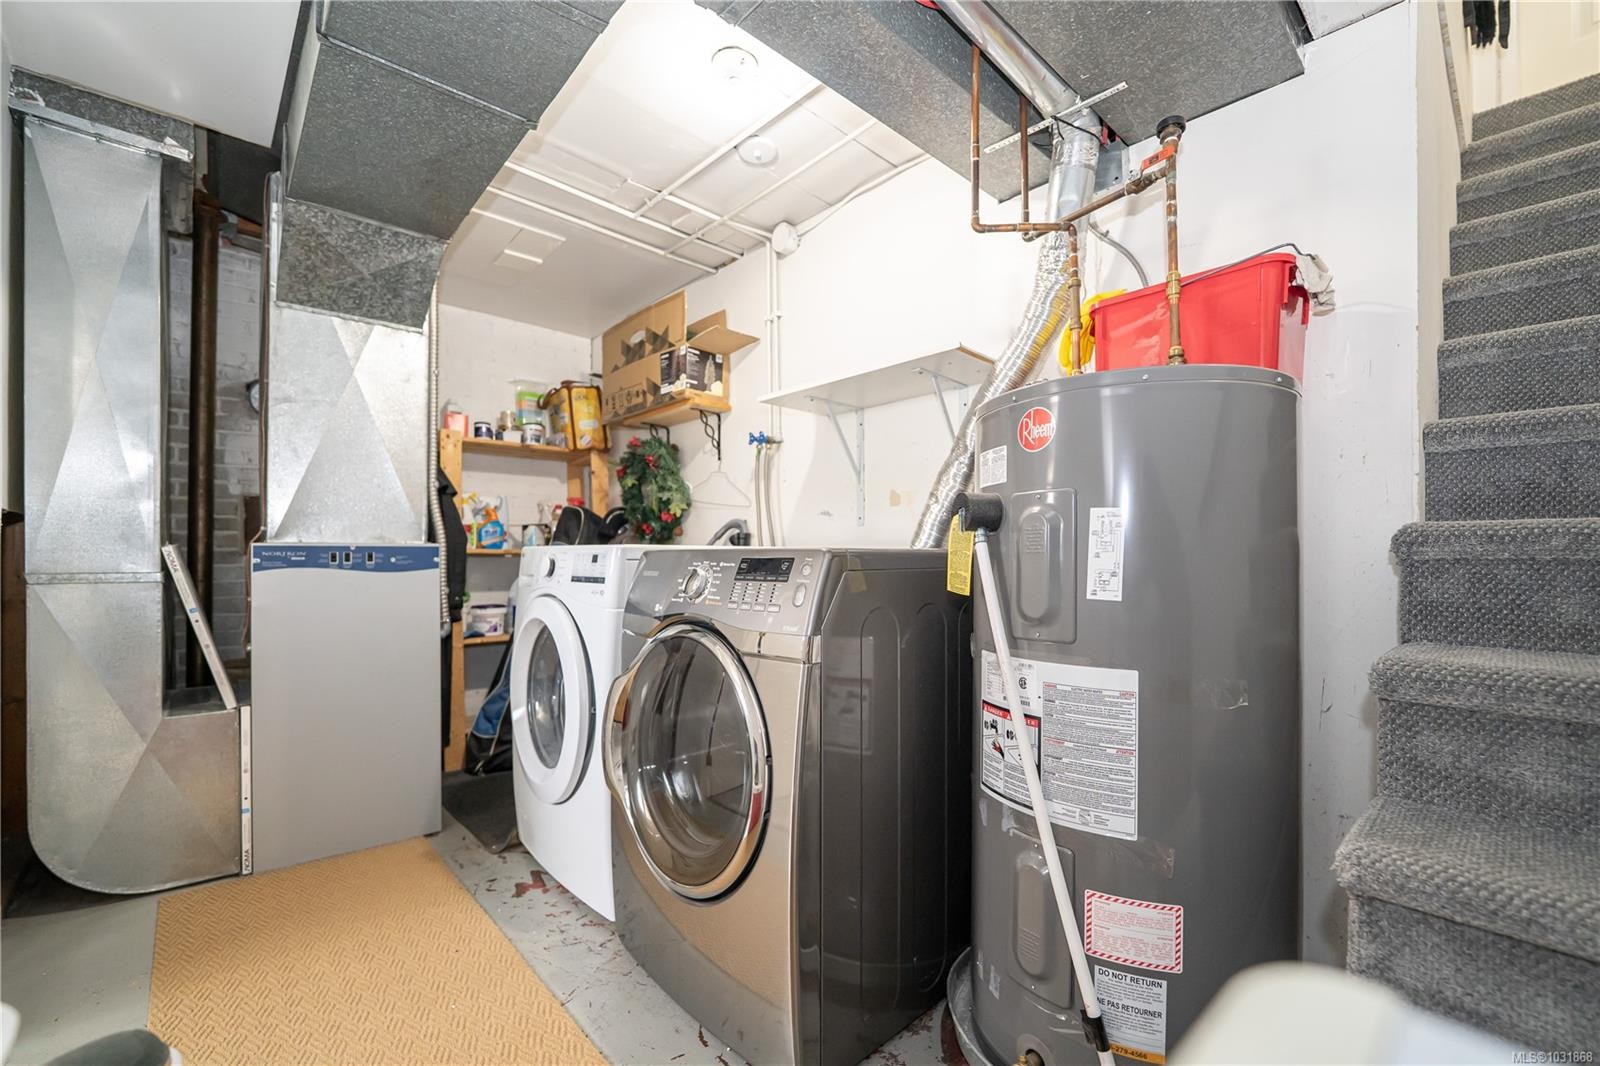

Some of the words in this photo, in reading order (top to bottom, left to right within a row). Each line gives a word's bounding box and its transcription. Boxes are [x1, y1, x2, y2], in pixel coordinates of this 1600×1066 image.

[1022, 410, 1054, 445] Rheem
[164, 550, 179, 572] NOMA
[1098, 968, 1110, 977] DO
[1111, 971, 1128, 981] NOT
[1130, 976, 1163, 989] RETURN
[1107, 1000, 1120, 1010] PAS
[1121, 1004, 1163, 1019] RETOURNER
